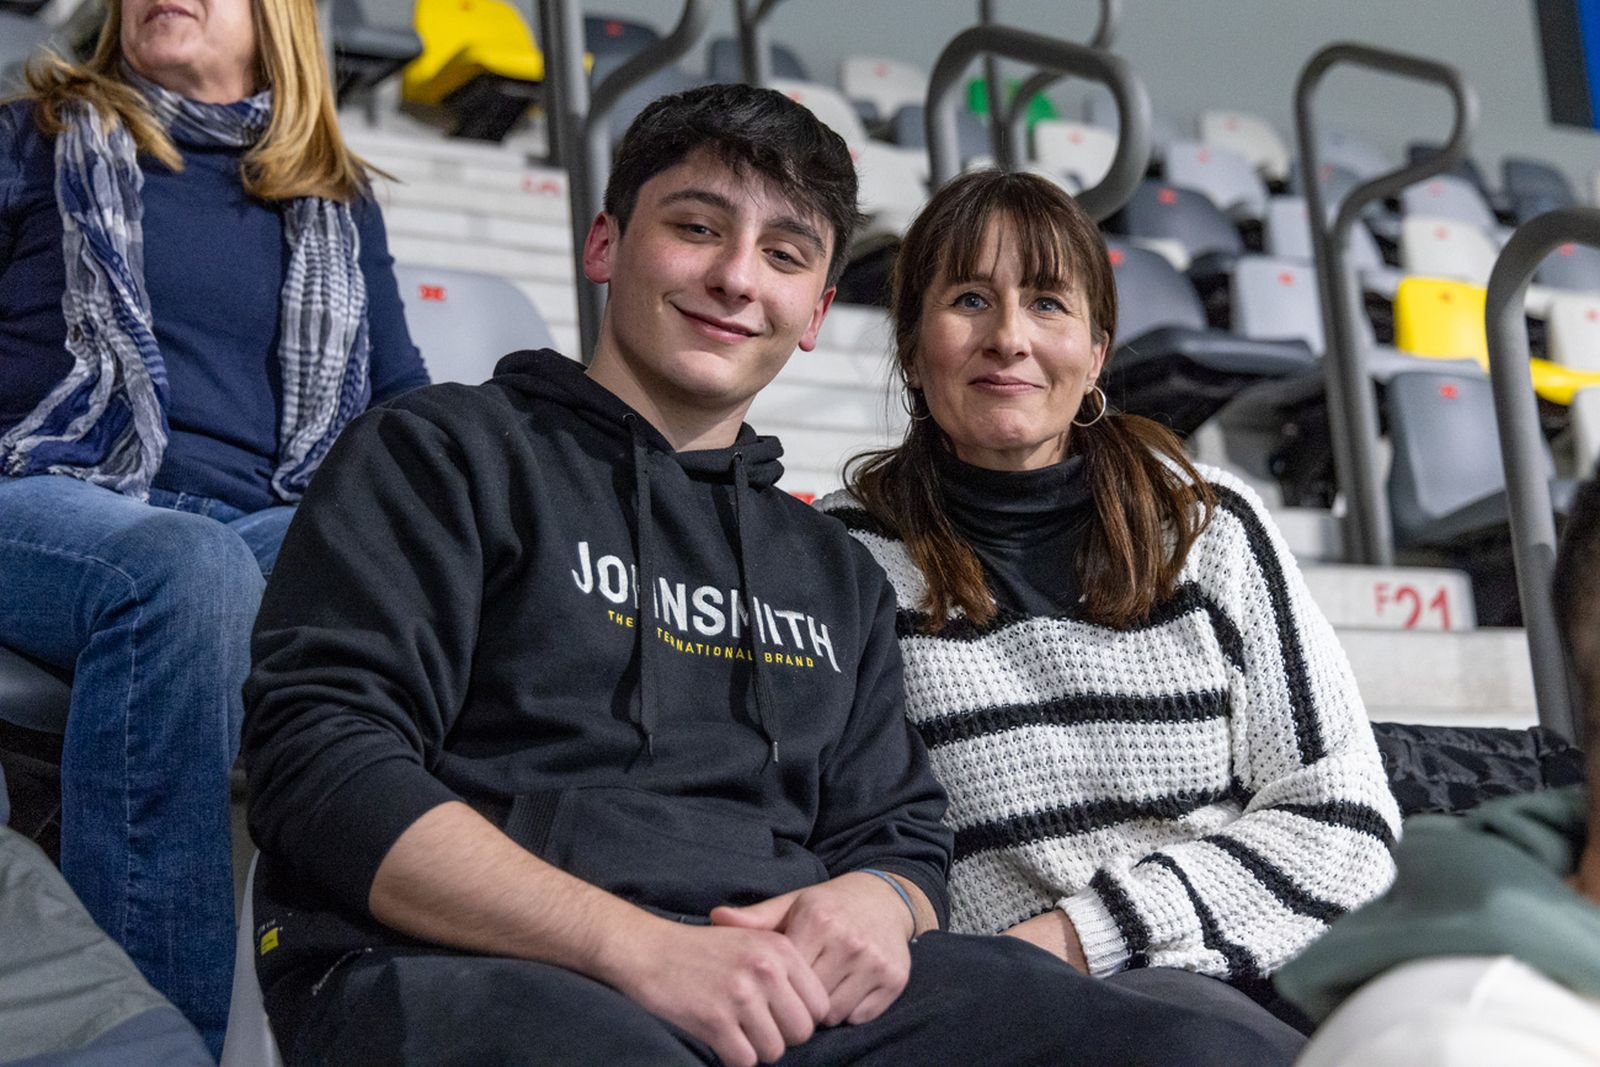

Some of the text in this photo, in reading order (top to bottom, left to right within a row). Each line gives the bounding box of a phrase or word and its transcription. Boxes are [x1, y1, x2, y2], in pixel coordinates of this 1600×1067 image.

[607, 609, 815, 668] THE TERNATIONAL BRAND
